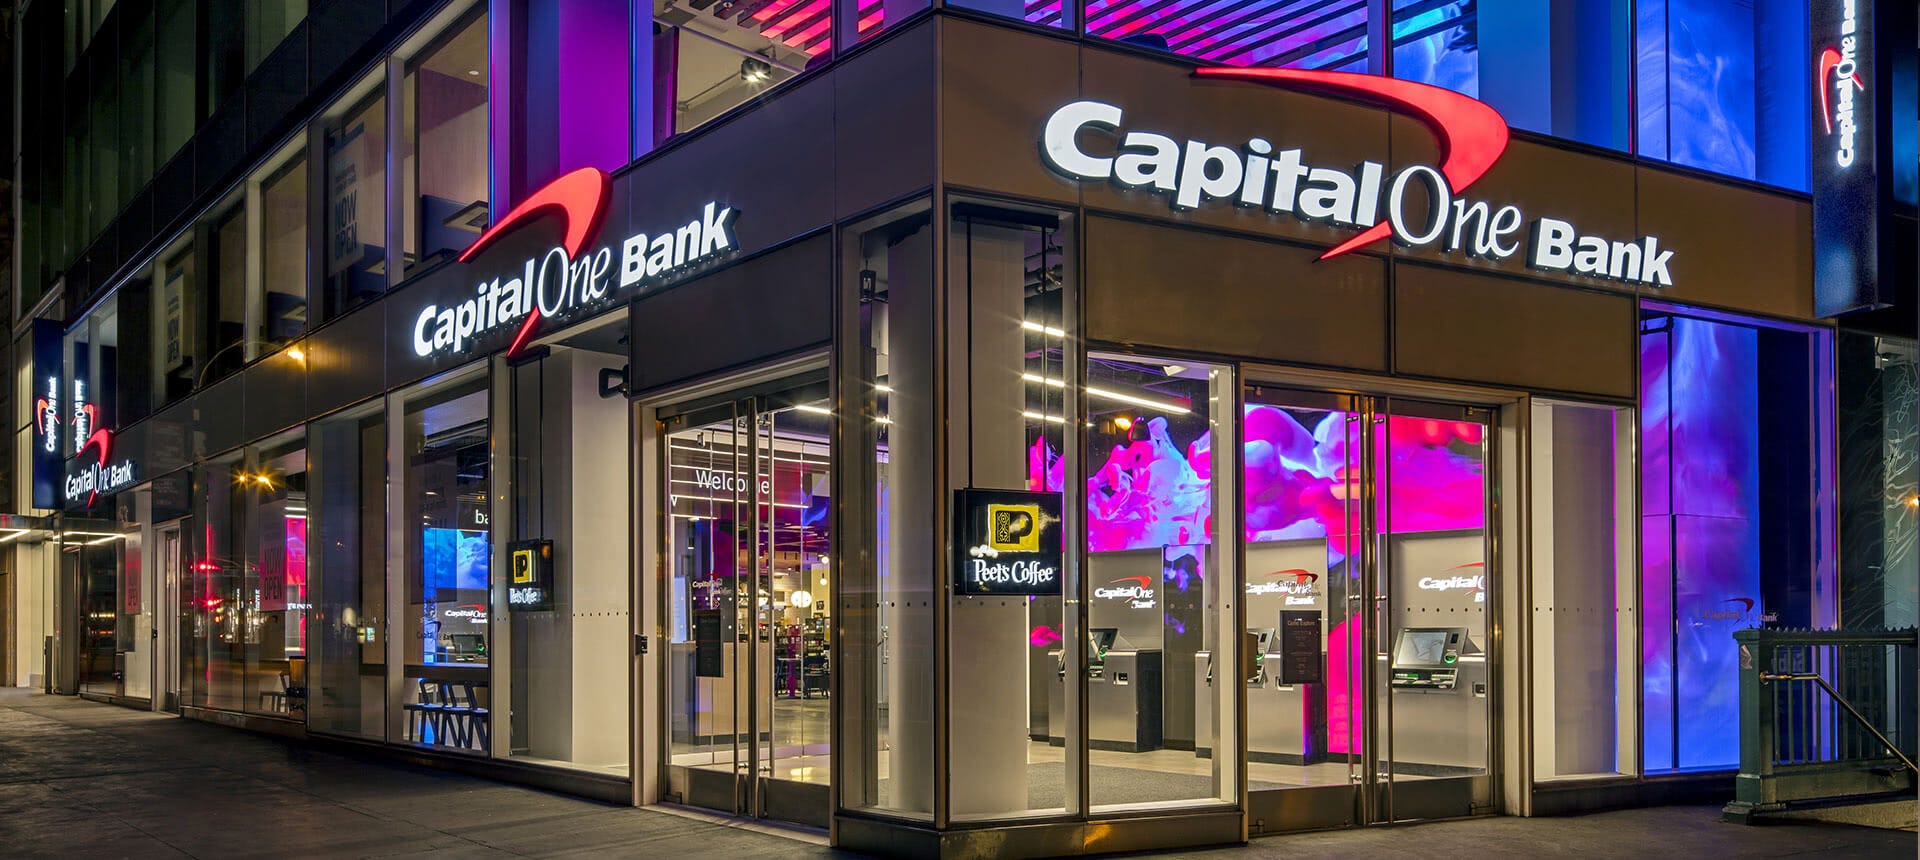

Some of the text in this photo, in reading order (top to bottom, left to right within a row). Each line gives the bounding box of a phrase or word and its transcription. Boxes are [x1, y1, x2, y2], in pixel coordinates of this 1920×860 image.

[1044, 101, 1674, 287] Capital One Bank
[414, 201, 732, 357] Capital One Bank
[65, 464, 95, 500] Capital
[111, 460, 132, 487] Bank
[696, 469, 770, 495] Welcoe
[973, 559, 1054, 586] Peet's Coffee
